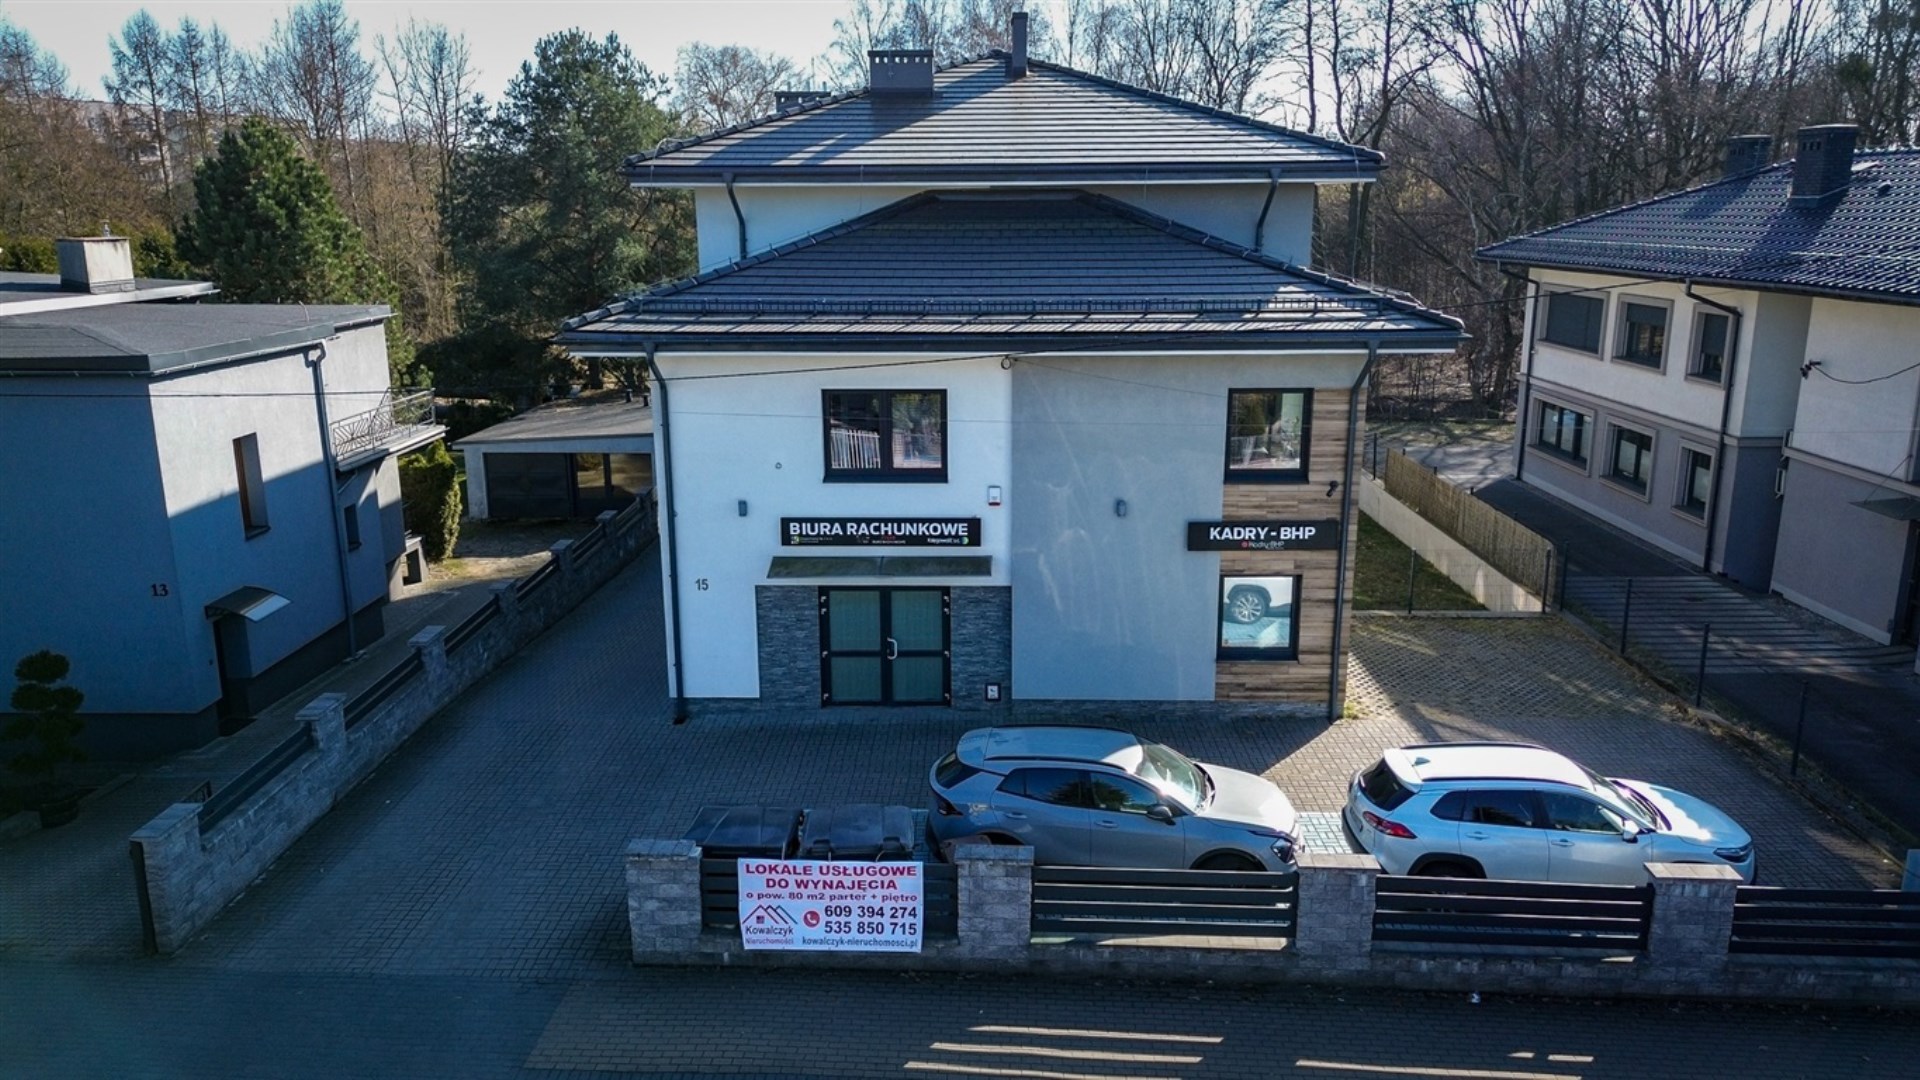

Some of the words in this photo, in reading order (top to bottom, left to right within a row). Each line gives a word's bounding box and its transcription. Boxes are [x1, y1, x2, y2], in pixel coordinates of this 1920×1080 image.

[789, 522, 843, 535] BIURA
[846, 522, 968, 535] RACHUNKOWE
[1209, 526, 1269, 540] KADRY
[1280, 526, 1316, 540] BHP
[151, 583, 169, 597] 13
[695, 578, 709, 591] 15
[745, 863, 813, 876] LOKALE
[819, 865, 917, 877] USŁUGOWE
[765, 878, 790, 889] DO
[795, 879, 898, 892] WYNAJĘCIA
[757, 892, 785, 900] pow.
[788, 892, 804, 900] 80
[806, 892, 825, 901] m2
[829, 893, 867, 901] parter
[881, 893, 918, 903] piętro
[824, 905, 852, 918] 609
[857, 905, 885, 918] 394
[889, 906, 918, 919] 274
[745, 925, 794, 937] Kowalczyk
[824, 920, 852, 934] 535
[857, 921, 884, 935] 850
[889, 922, 917, 936] 715
